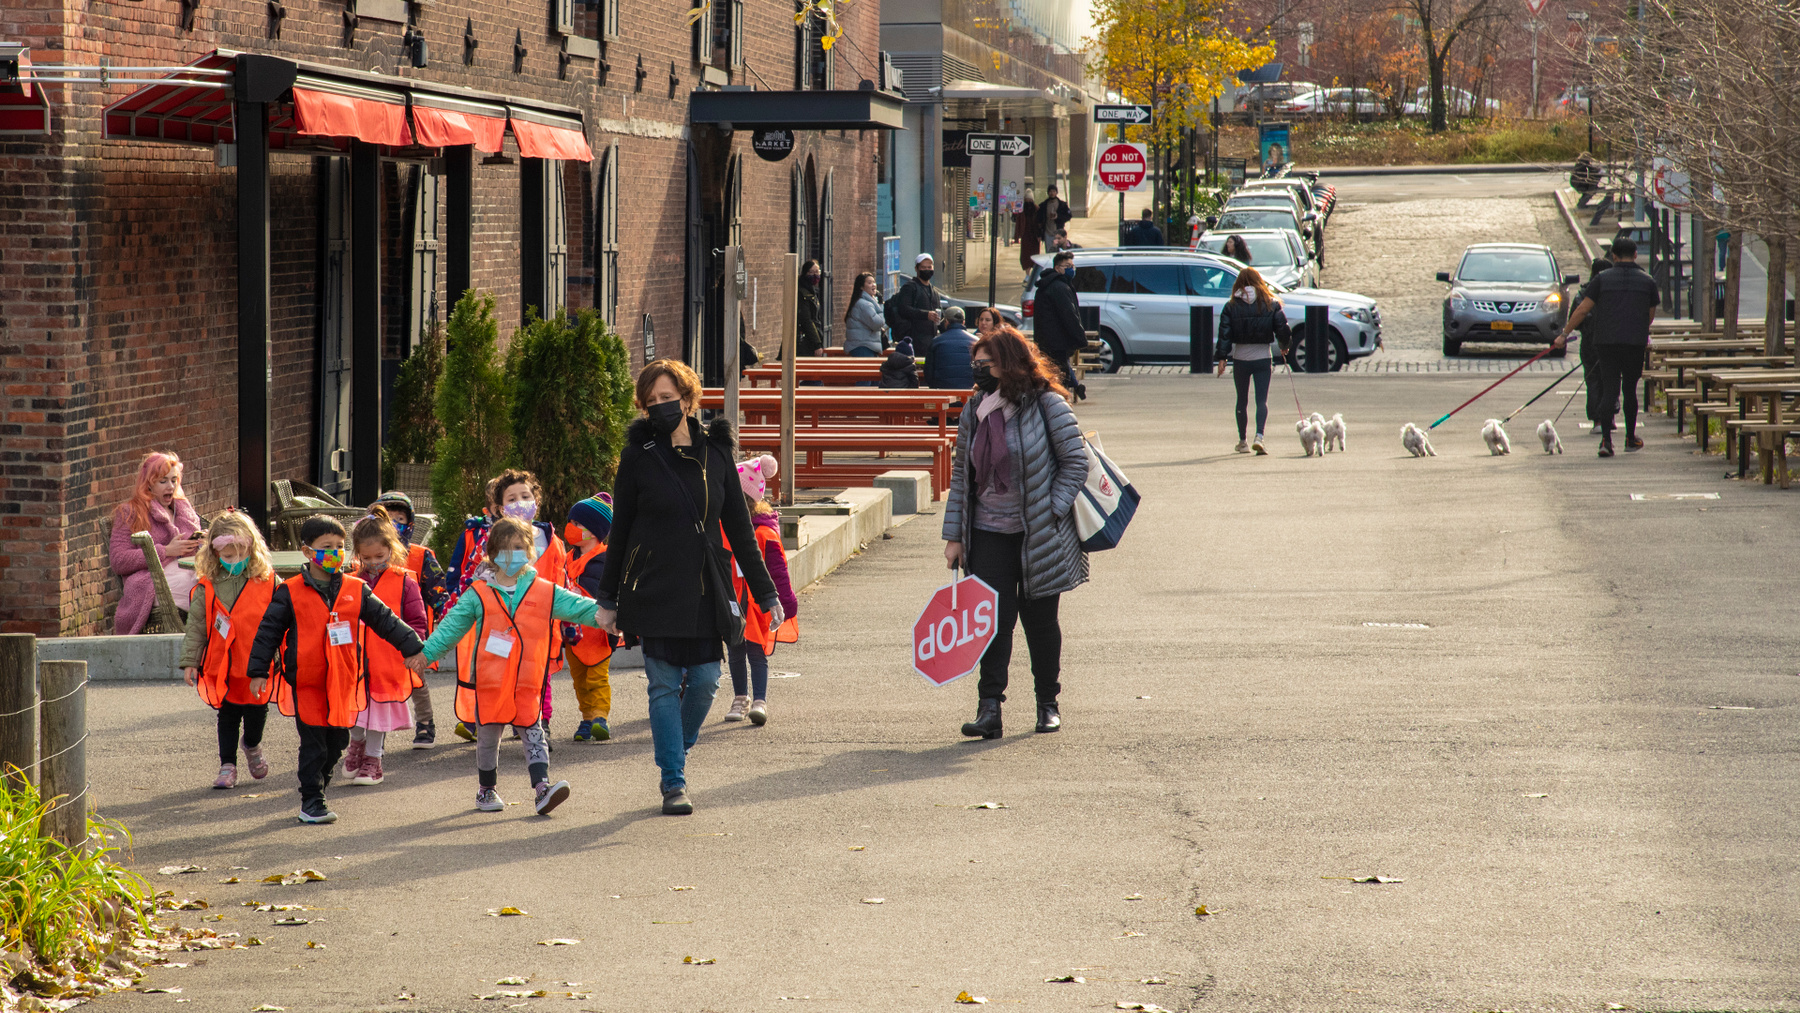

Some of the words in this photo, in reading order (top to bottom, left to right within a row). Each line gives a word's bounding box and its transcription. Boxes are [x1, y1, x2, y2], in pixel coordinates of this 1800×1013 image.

[1102, 110, 1118, 118] ONE
[972, 140, 991, 149] ONE
[1002, 141, 1022, 150] WAY
[1105, 153, 1117, 161] DO
[1122, 153, 1139, 161] NOT
[1108, 174, 1136, 182] ENTER
[918, 600, 992, 661] STOP
